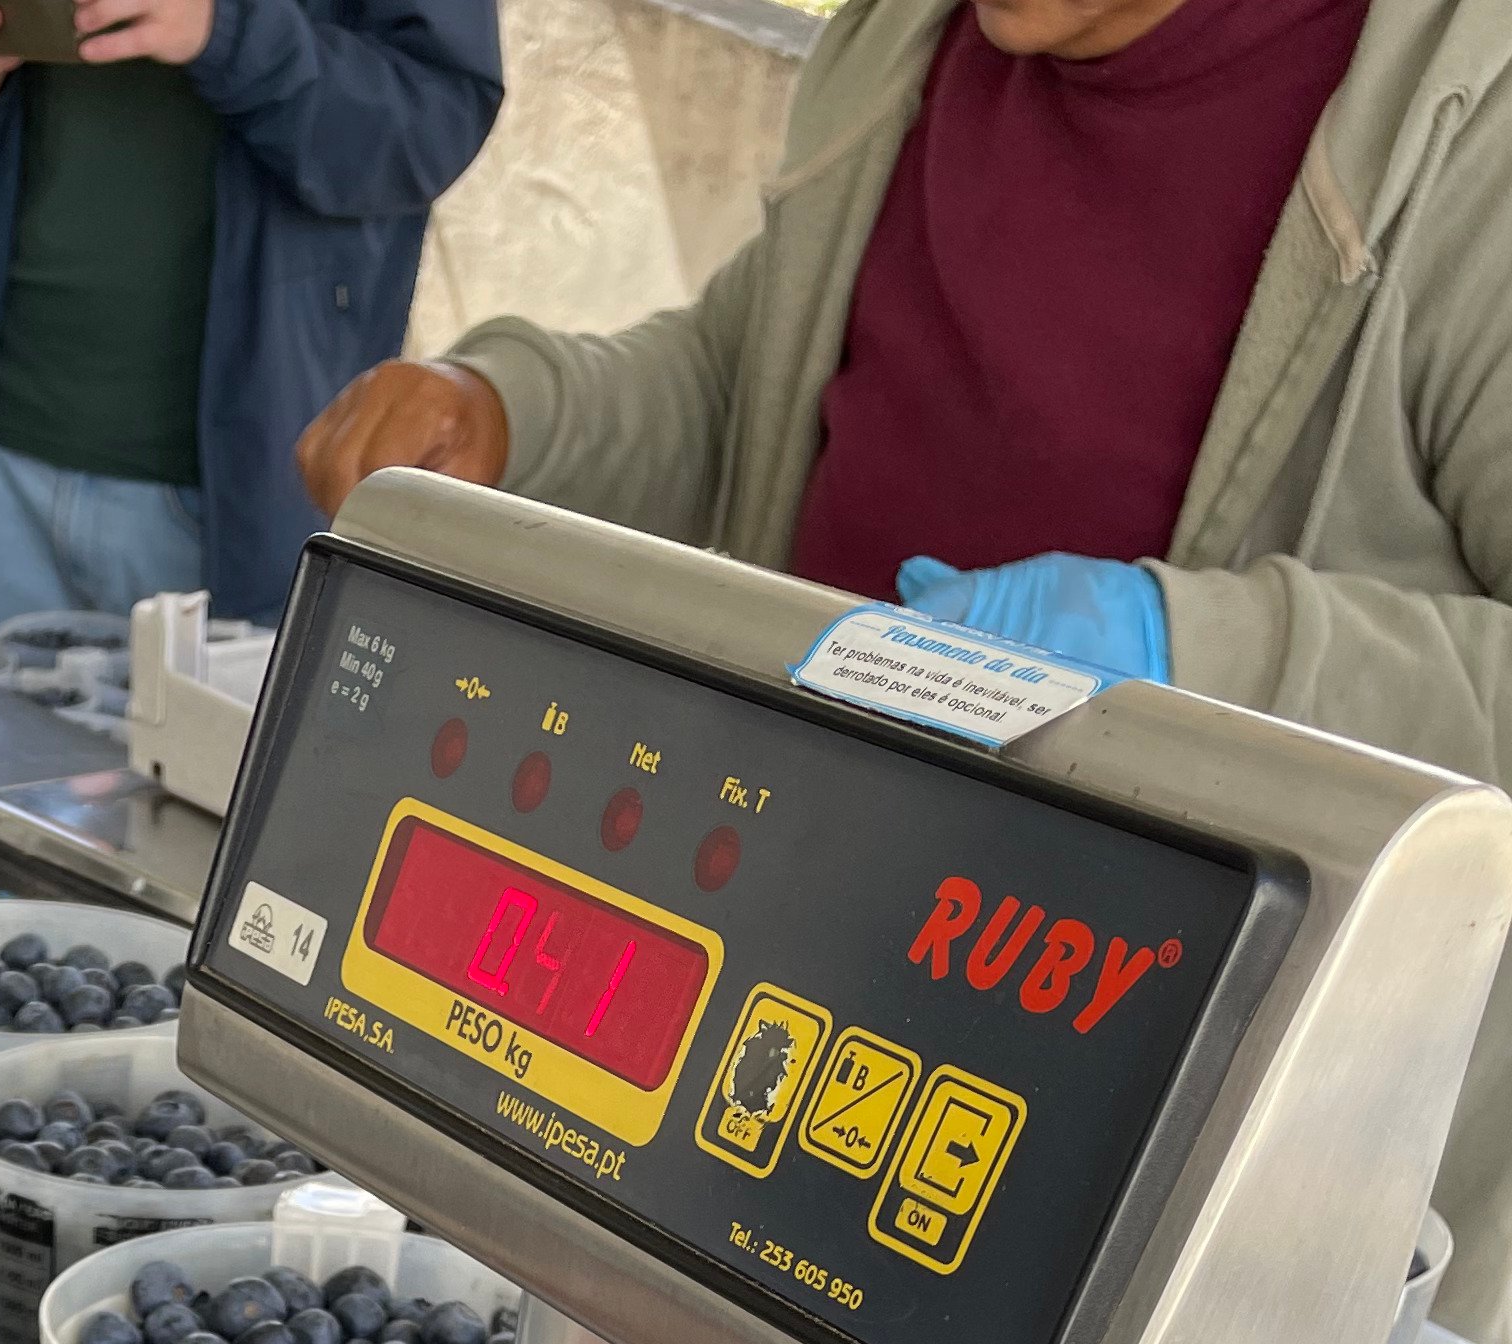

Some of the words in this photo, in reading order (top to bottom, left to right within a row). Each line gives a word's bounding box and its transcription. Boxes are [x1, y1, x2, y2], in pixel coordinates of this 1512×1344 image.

[339, 651, 359, 674] Min
[347, 625, 372, 650] Max
[370, 636, 381, 653] 6
[379, 639, 396, 663] kg
[880, 625, 987, 666] Pensamento
[983, 653, 1012, 675] do
[1009, 663, 1050, 686] dia
[331, 680, 340, 695] e
[350, 686, 361, 704] 2
[358, 693, 371, 712] g
[827, 640, 846, 656] Ter
[844, 647, 906, 674] problemas
[906, 664, 926, 677] na
[924, 667, 953, 685] vida
[951, 675, 963, 690] é
[1026, 701, 1052, 717] ser
[832, 666, 889, 688] derrotado
[888, 682, 912, 697] por
[911, 684, 937, 702] eles
[947, 695, 1007, 724] opcional.
[629, 742, 663, 774] Net
[719, 776, 749, 809] Fix.
[754, 788, 771, 814] T
[290, 923, 315, 962] 14
[445, 1000, 503, 1053] PESO
[504, 1031, 533, 1079] kg
[496, 1090, 626, 1181] www.ipesa.pt
[907, 1208, 932, 1233] ON
[728, 1221, 758, 1254] Tel.:
[759, 1240, 792, 1272] 253
[794, 1259, 827, 1292] 605
[828, 1277, 864, 1311] 950
